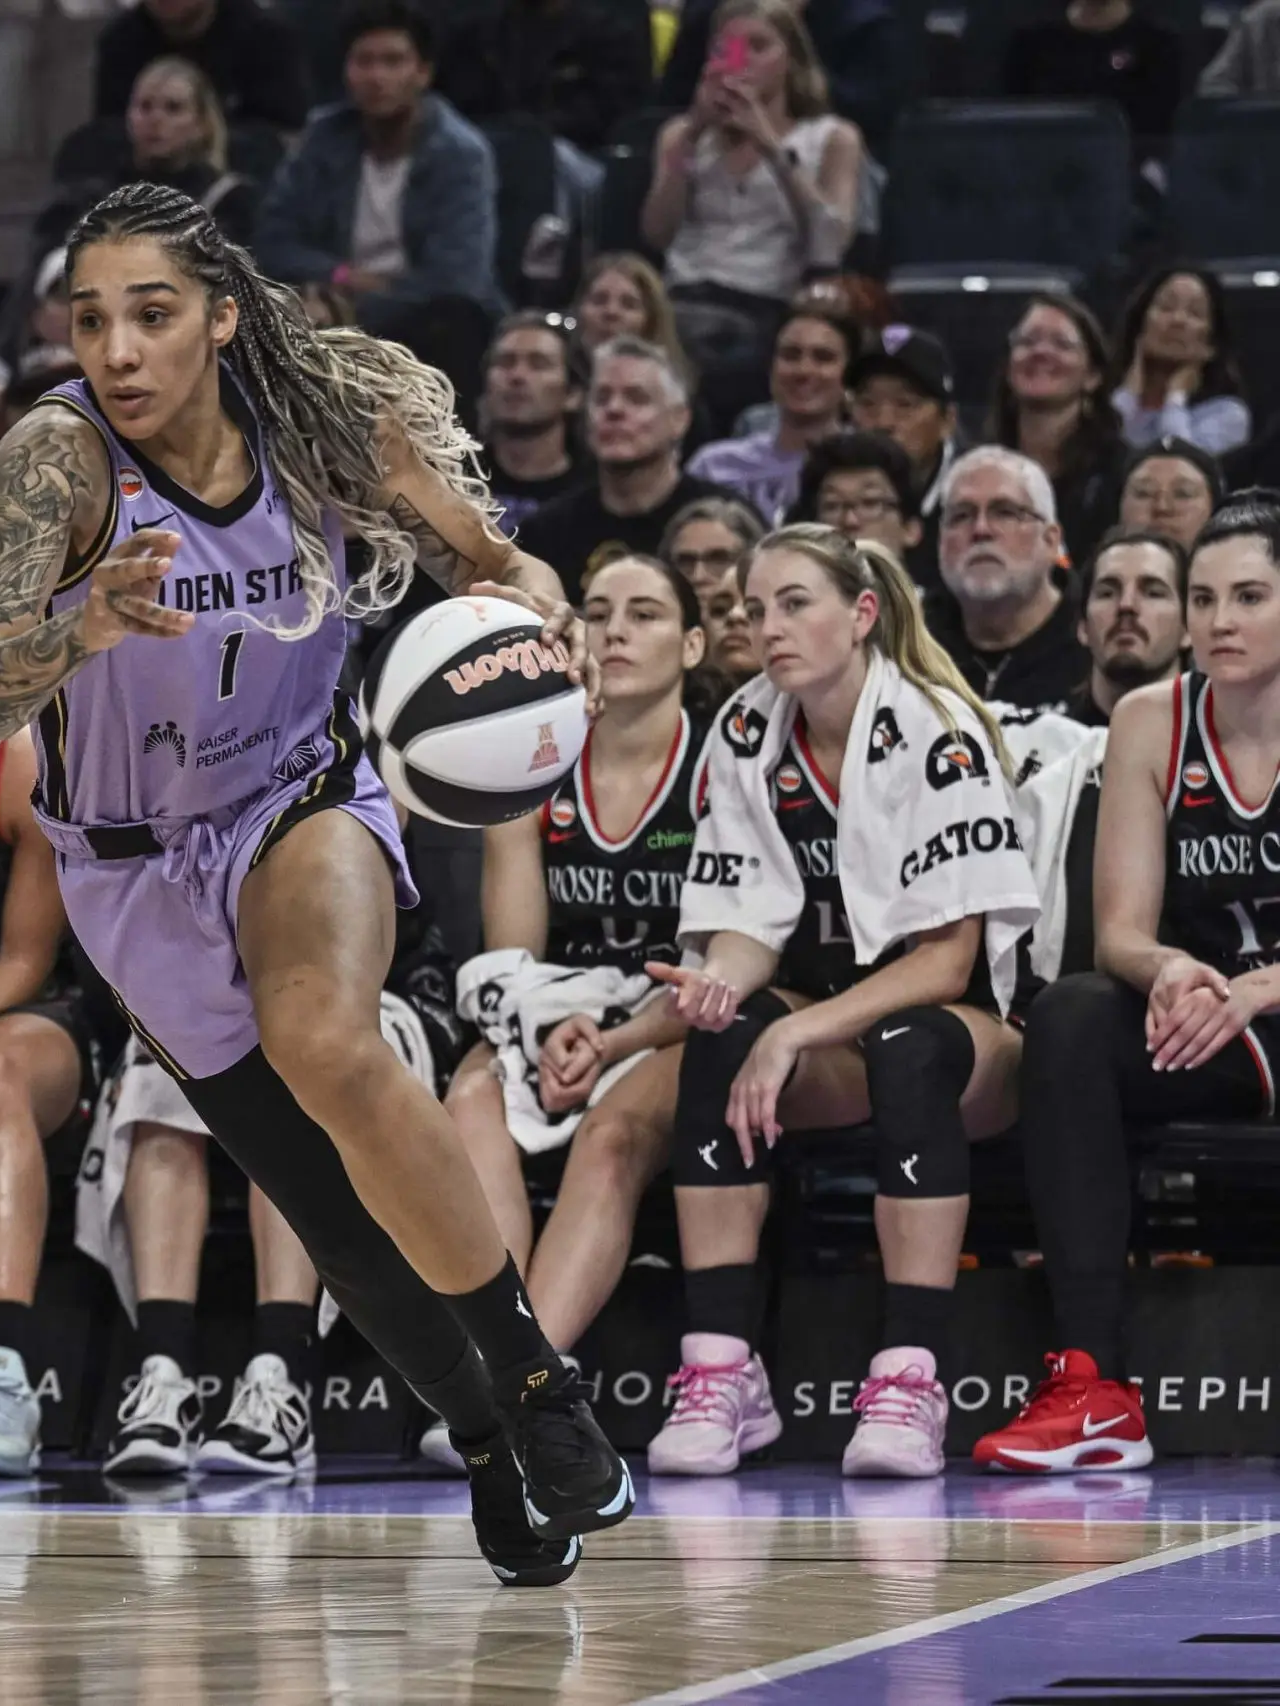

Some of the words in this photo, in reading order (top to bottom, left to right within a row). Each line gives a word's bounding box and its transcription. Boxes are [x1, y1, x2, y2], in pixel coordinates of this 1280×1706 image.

[159, 571, 235, 614] LDEN
[246, 559, 304, 605] STA
[218, 630, 245, 702] 1
[196, 727, 239, 753] KAISER
[196, 726, 281, 770] PERMANENTE
[1177, 834, 1255, 878] ROSE
[623, 869, 686, 908] CIT
